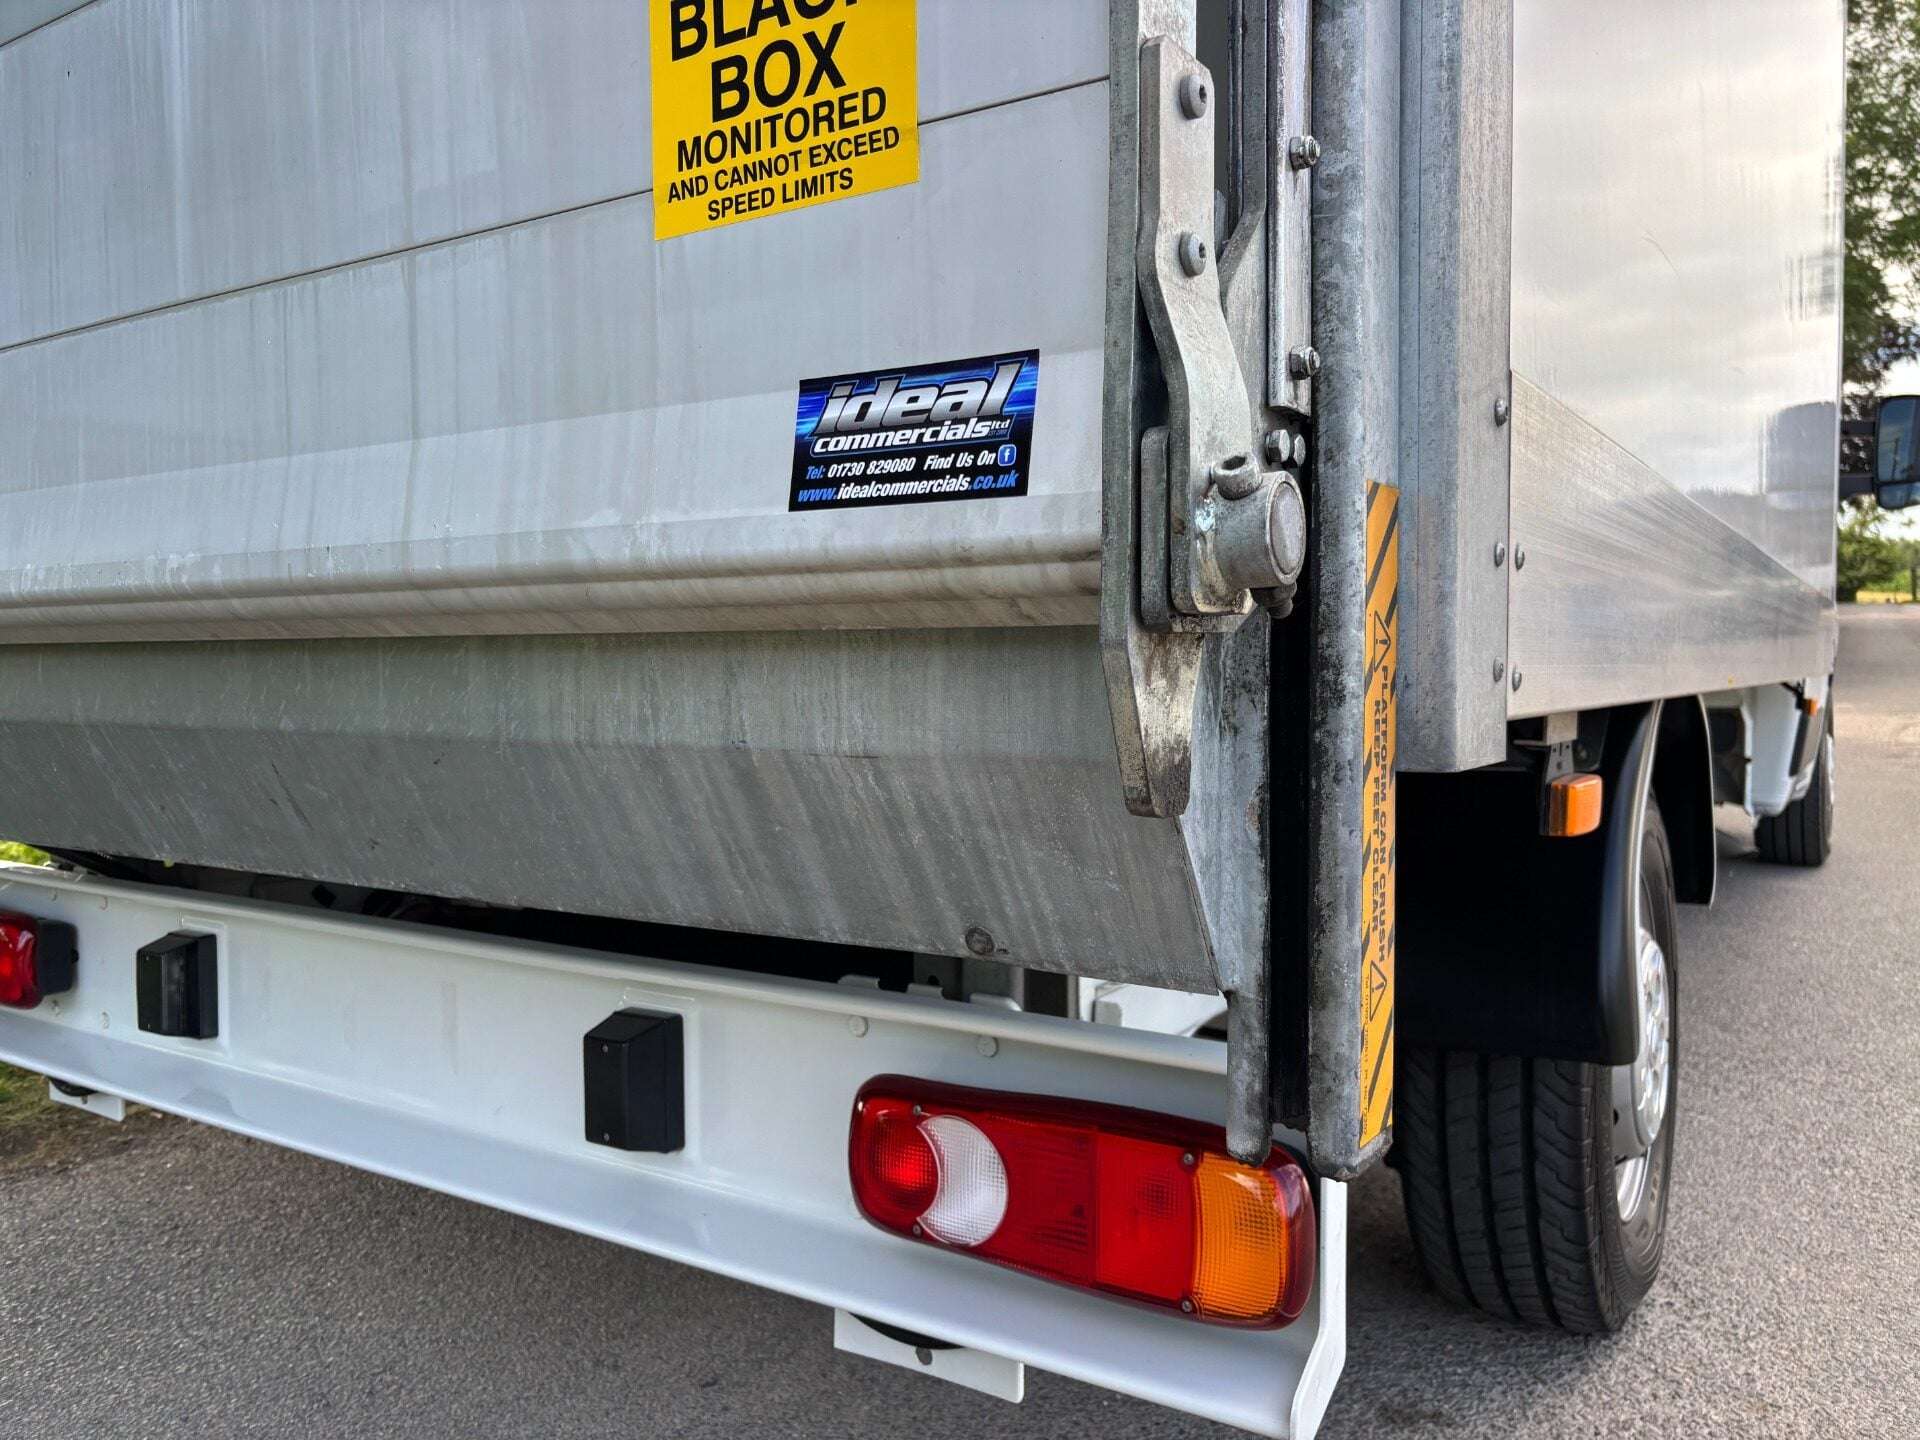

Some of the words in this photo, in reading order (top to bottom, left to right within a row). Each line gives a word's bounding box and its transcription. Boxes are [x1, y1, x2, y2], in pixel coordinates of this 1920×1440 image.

[711, 21, 846, 123] BOX
[668, 175, 709, 203] AND
[714, 149, 802, 191] CANNOT
[808, 126, 900, 168] EXCEED
[677, 86, 887, 172] MONITORED
[708, 187, 775, 221] SPEED
[782, 167, 854, 204] LIMITS
[813, 361, 1022, 434] ideal
[805, 465, 826, 480] Tel:
[827, 462, 865, 478] 01730
[867, 457, 917, 475] 829080
[923, 453, 955, 471] Find
[956, 451, 973, 467] Us
[977, 450, 996, 465] On
[813, 417, 991, 453] commercials
[798, 469, 1019, 503] www.idealcommercials.co.uk
[1378, 873, 1386, 963] CRUSH
